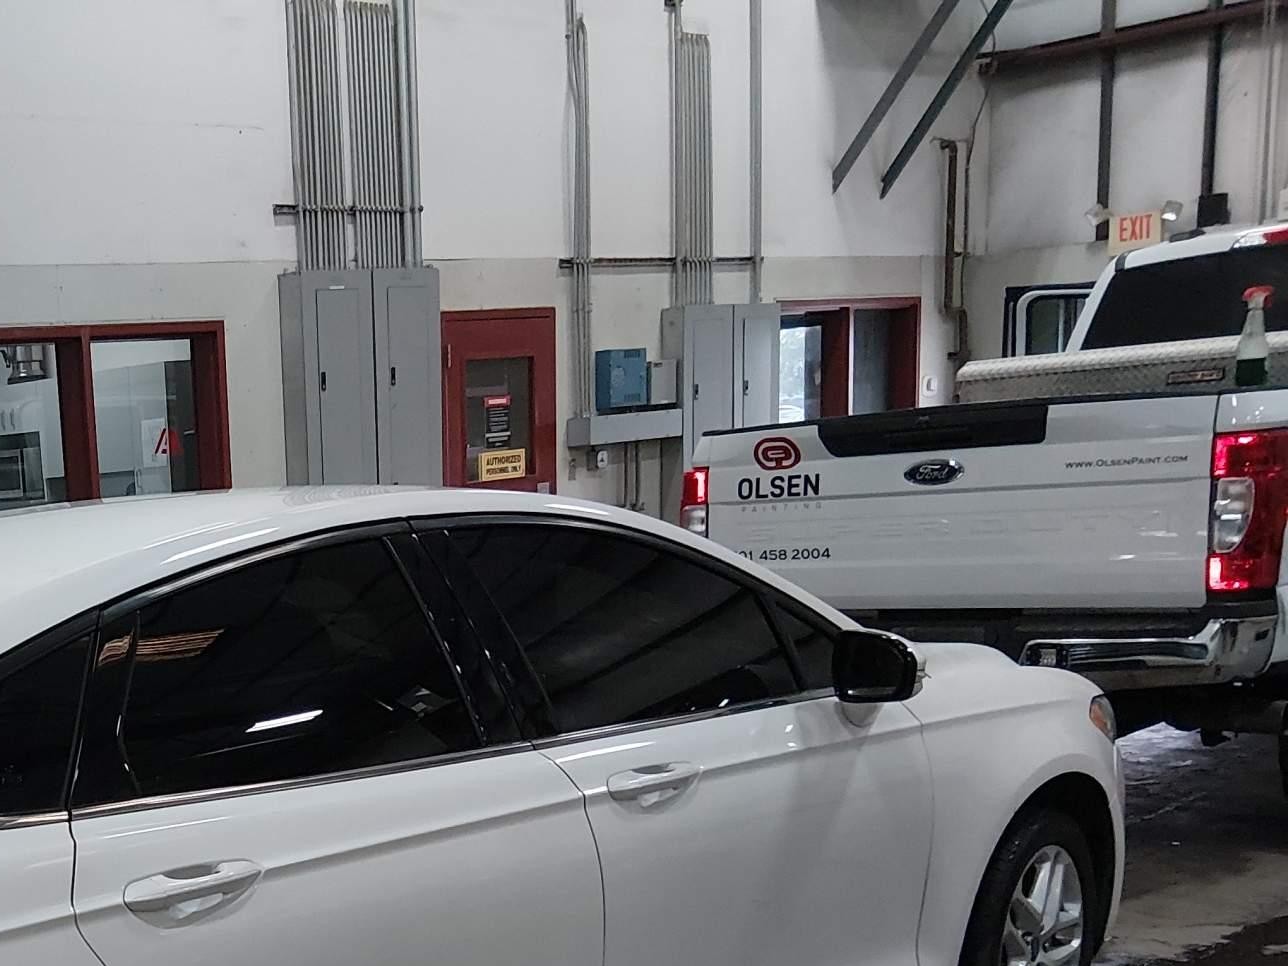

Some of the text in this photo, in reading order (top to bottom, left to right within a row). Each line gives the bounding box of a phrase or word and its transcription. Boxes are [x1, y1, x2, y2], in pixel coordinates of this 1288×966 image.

[1119, 213, 1153, 242] EXIT
[486, 454, 522, 466] AUTHORIZED
[916, 464, 949, 480] Ford
[737, 473, 821, 501] OLSEN
[759, 549, 788, 561] 458
[791, 547, 832, 560] 2004
